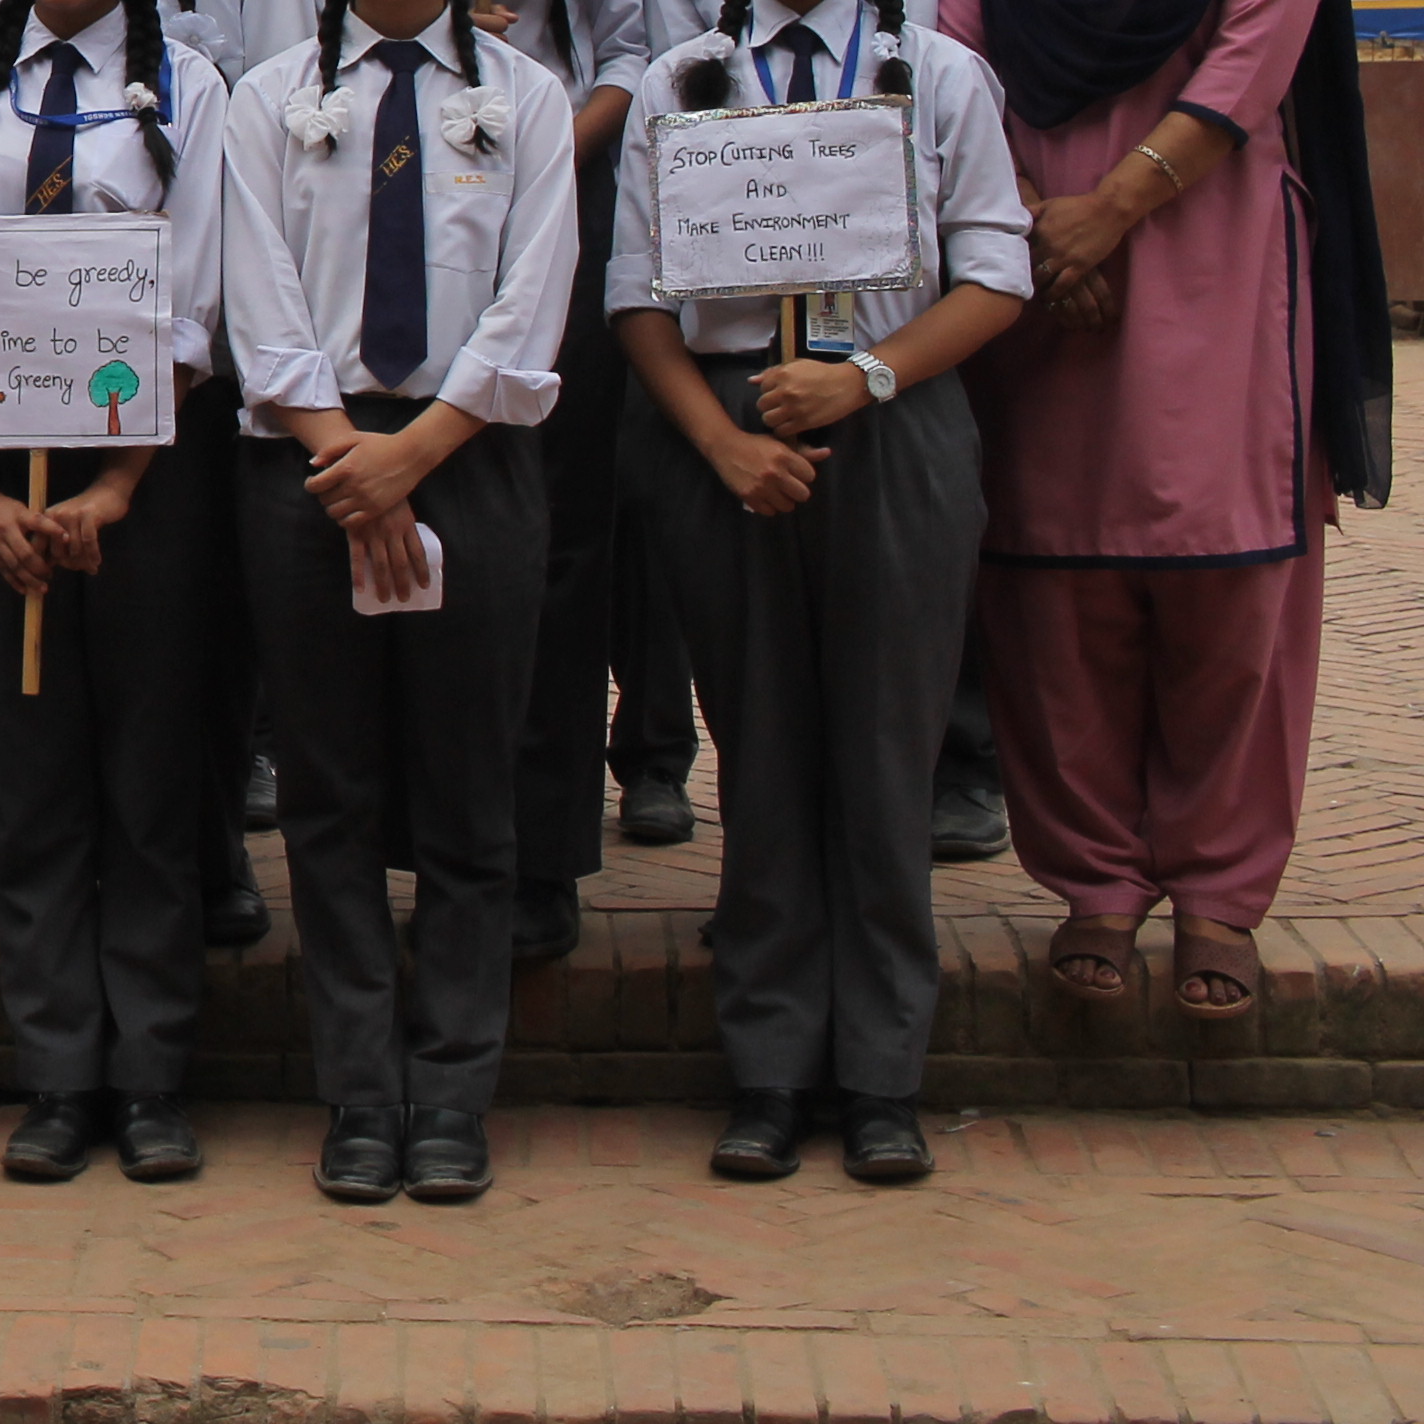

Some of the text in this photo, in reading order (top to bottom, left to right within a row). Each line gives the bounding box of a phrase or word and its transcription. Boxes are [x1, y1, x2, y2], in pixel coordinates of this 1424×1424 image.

[746, 179, 787, 199] AND
[16, 259, 48, 287] be
[68, 259, 155, 307] greedy,
[51, 328, 77, 354] to
[97, 328, 130, 354] be
[8, 366, 74, 405] Greeny
